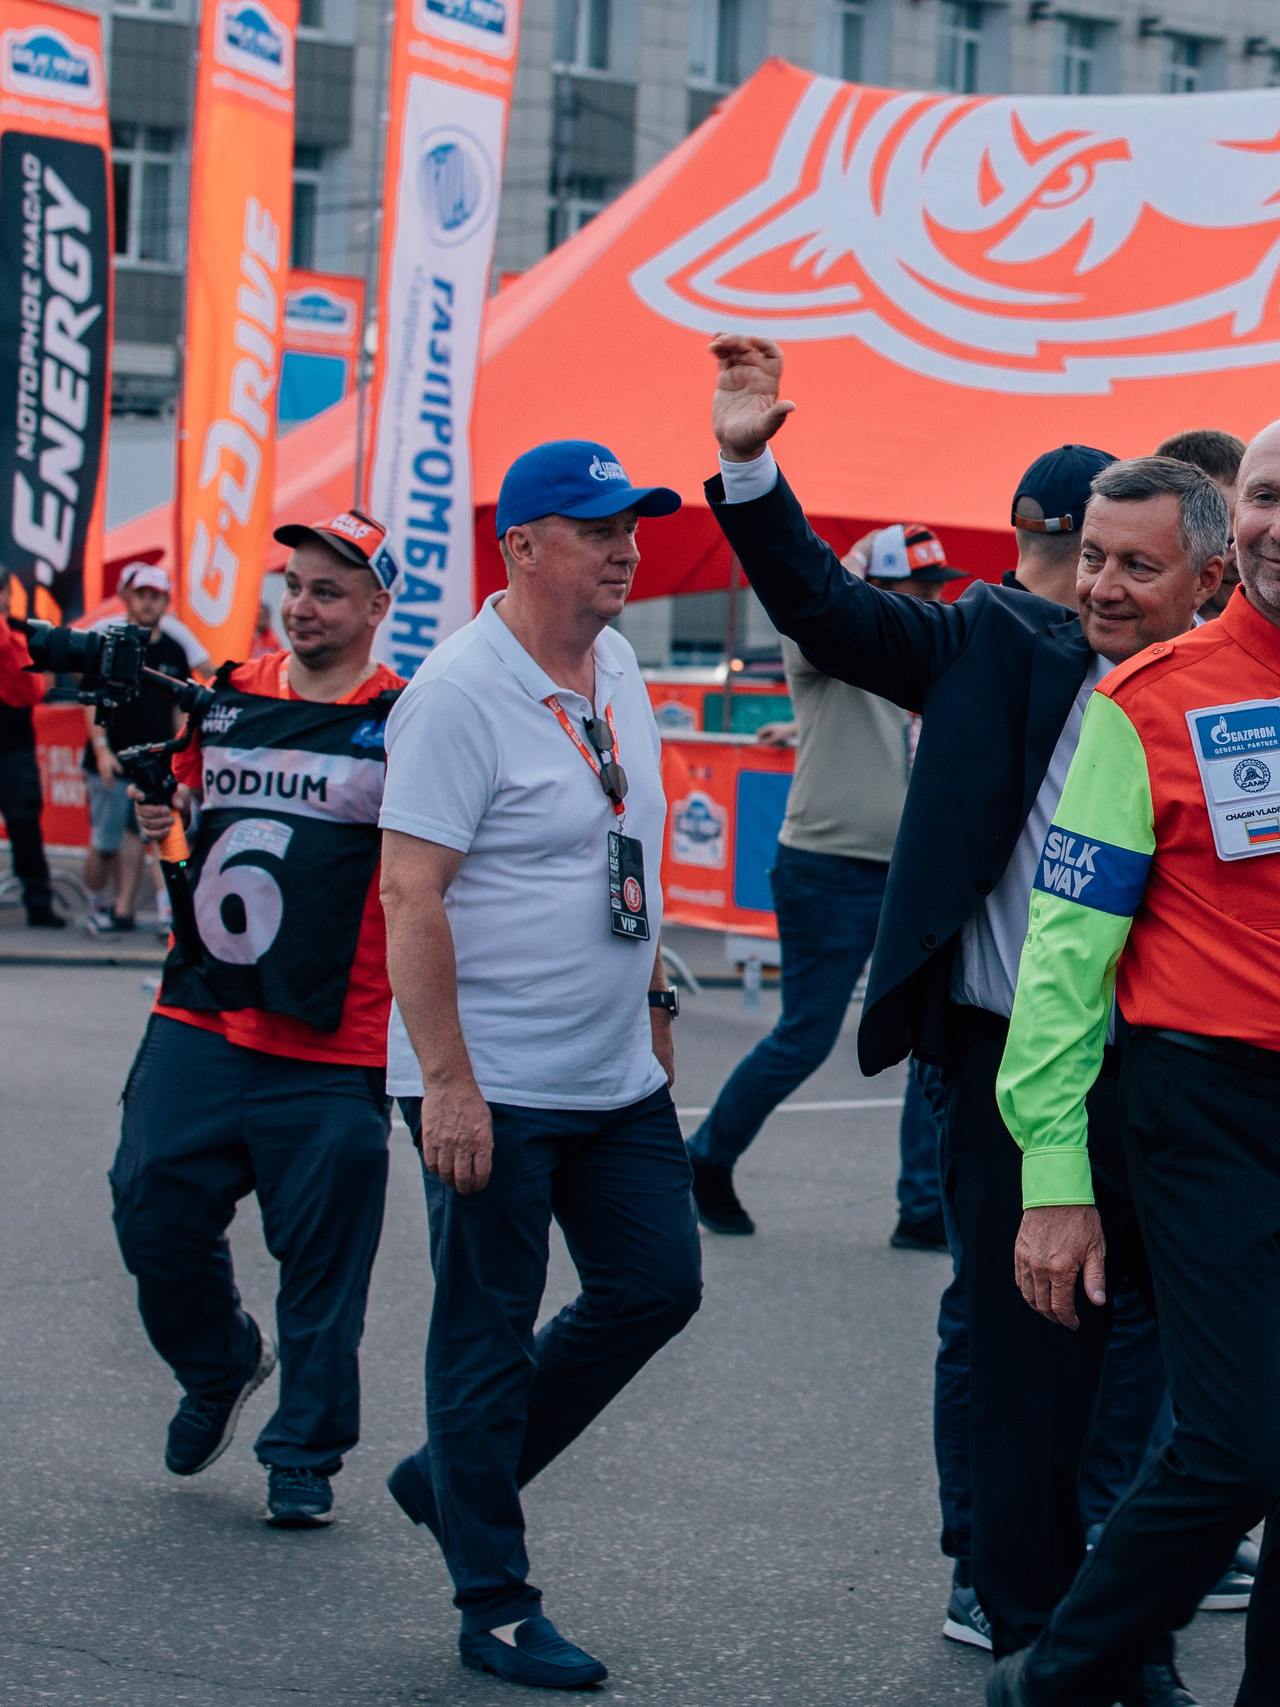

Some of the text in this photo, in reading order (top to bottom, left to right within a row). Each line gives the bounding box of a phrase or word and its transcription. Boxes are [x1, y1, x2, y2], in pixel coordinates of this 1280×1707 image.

[201, 719, 236, 733] WAY
[1231, 726, 1276, 743] GAZPROM
[1214, 739, 1279, 755] GENERAL PARTNER
[205, 768, 328, 803] PODIUM
[1225, 810, 1255, 821] CHAGIN
[1044, 831, 1101, 873] SILK
[1043, 859, 1094, 899] WAY
[194, 817, 294, 966] 6
[621, 916, 637, 933] VIP
